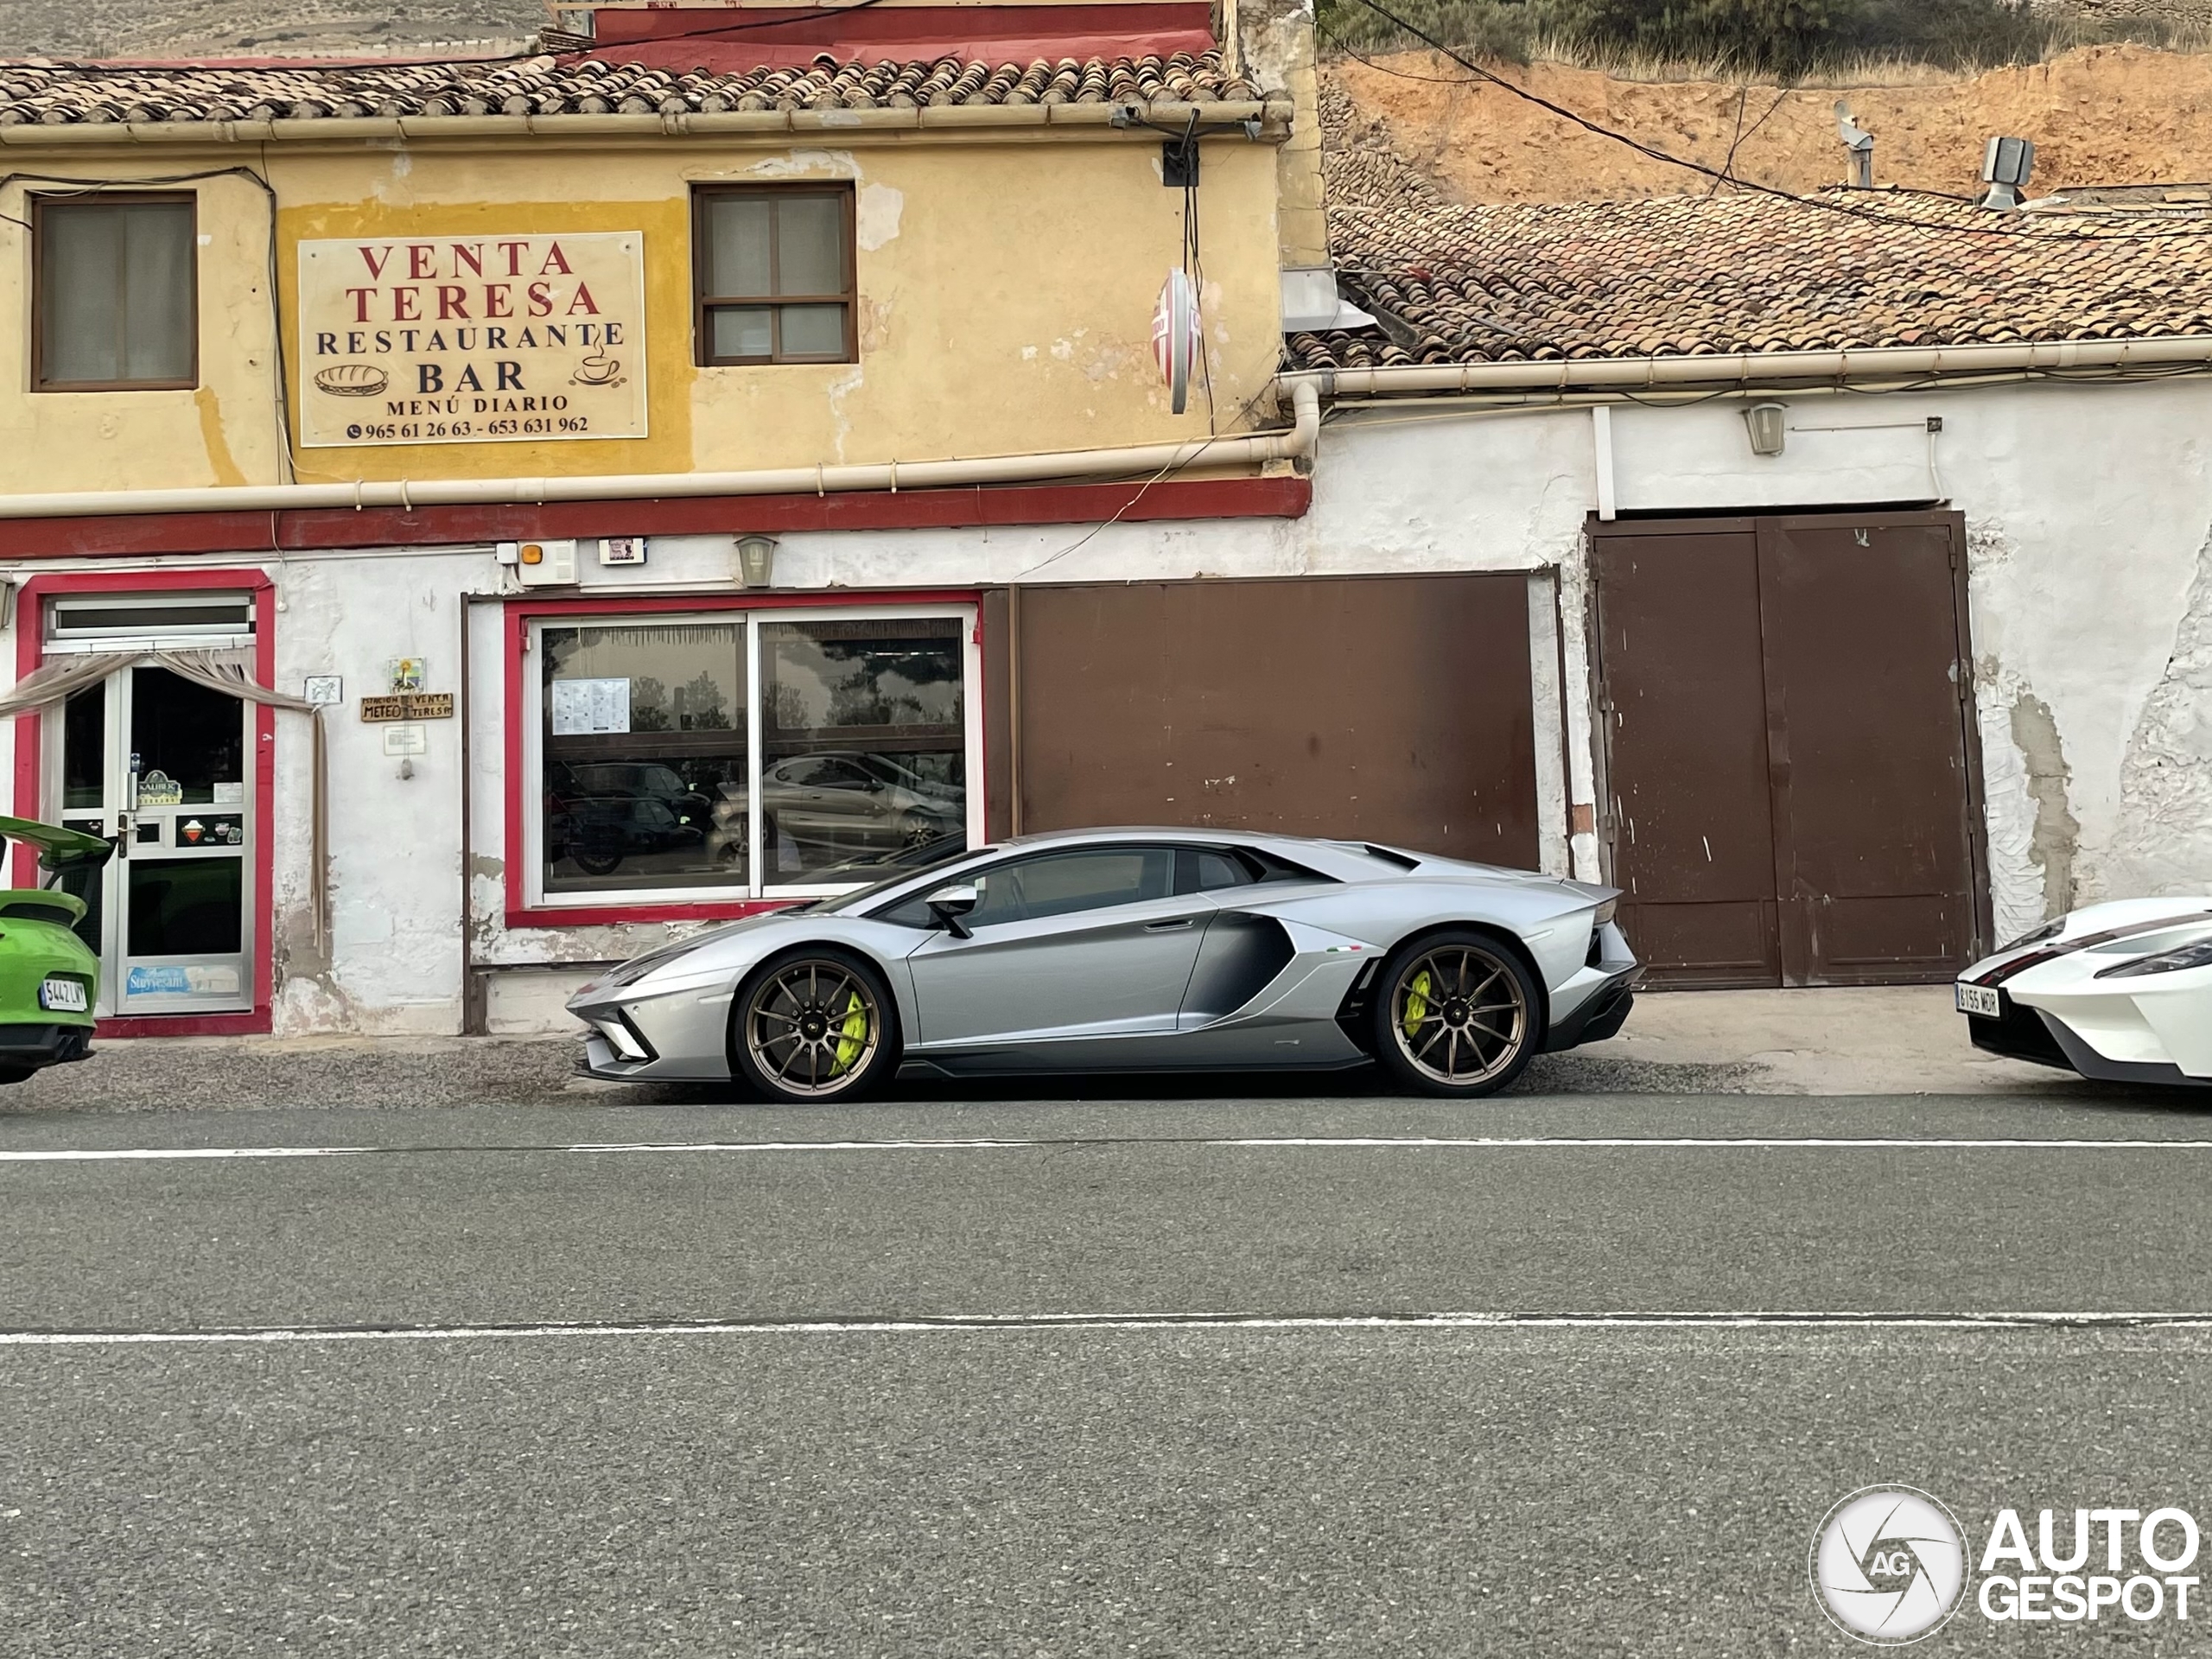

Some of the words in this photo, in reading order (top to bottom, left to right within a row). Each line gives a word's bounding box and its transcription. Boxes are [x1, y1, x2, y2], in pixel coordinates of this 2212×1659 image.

[358, 241, 574, 281] VENTA
[346, 281, 601, 323] TERESA
[316, 322, 624, 355] RESTAURANTE
[416, 360, 526, 394] BAR
[386, 395, 460, 416] MENÚ
[474, 395, 569, 413] DIARIO
[365, 423, 396, 439] 965
[401, 423, 419, 438] 61
[426, 422, 447, 437] 26
[451, 421, 471, 436] 63
[488, 420, 518, 435] 653
[524, 418, 552, 433] 631
[558, 417, 588, 432] 962
[415, 694, 448, 703] VENTA
[364, 705, 401, 718] METEO
[412, 707, 450, 716] TERESA
[46, 982, 69, 1002] 5442
